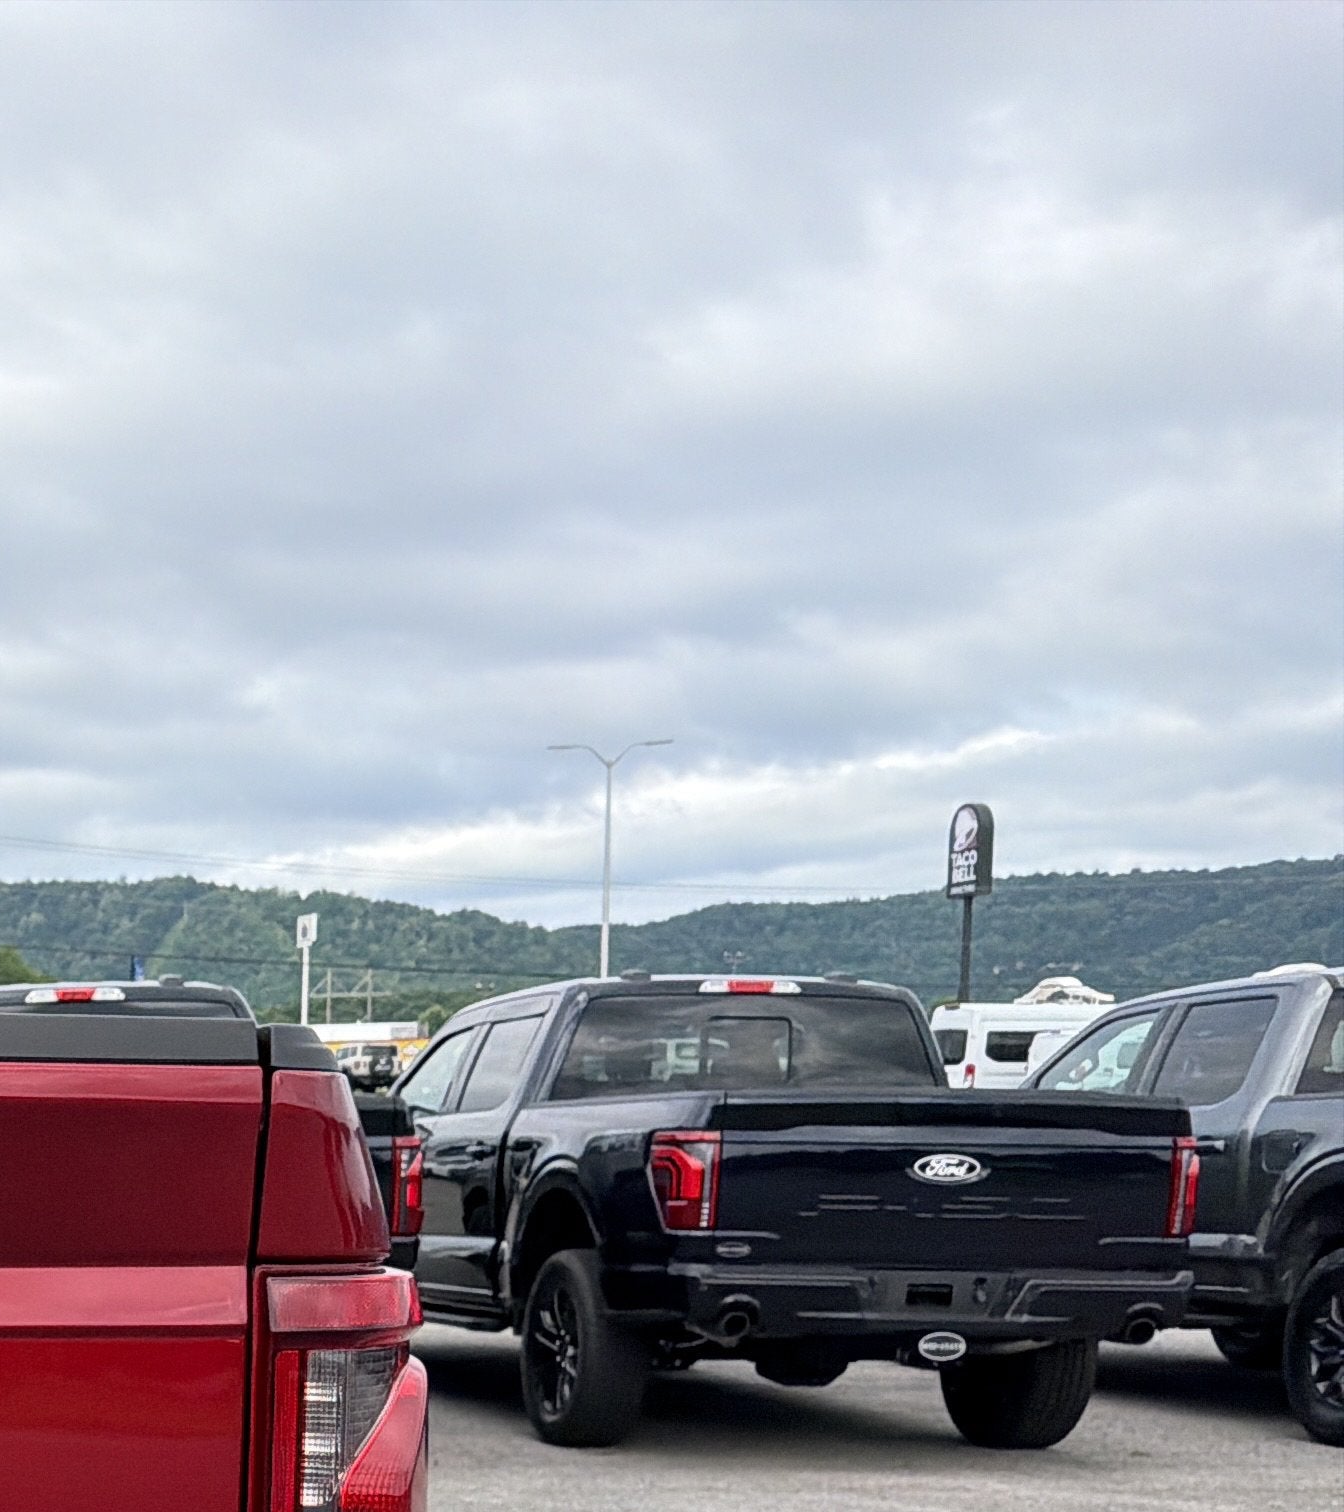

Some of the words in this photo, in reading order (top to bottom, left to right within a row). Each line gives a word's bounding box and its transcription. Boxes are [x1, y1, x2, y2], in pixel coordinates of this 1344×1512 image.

[950, 849, 978, 867] TACO
[951, 865, 977, 885] BELL
[925, 1158, 970, 1177] Ford
